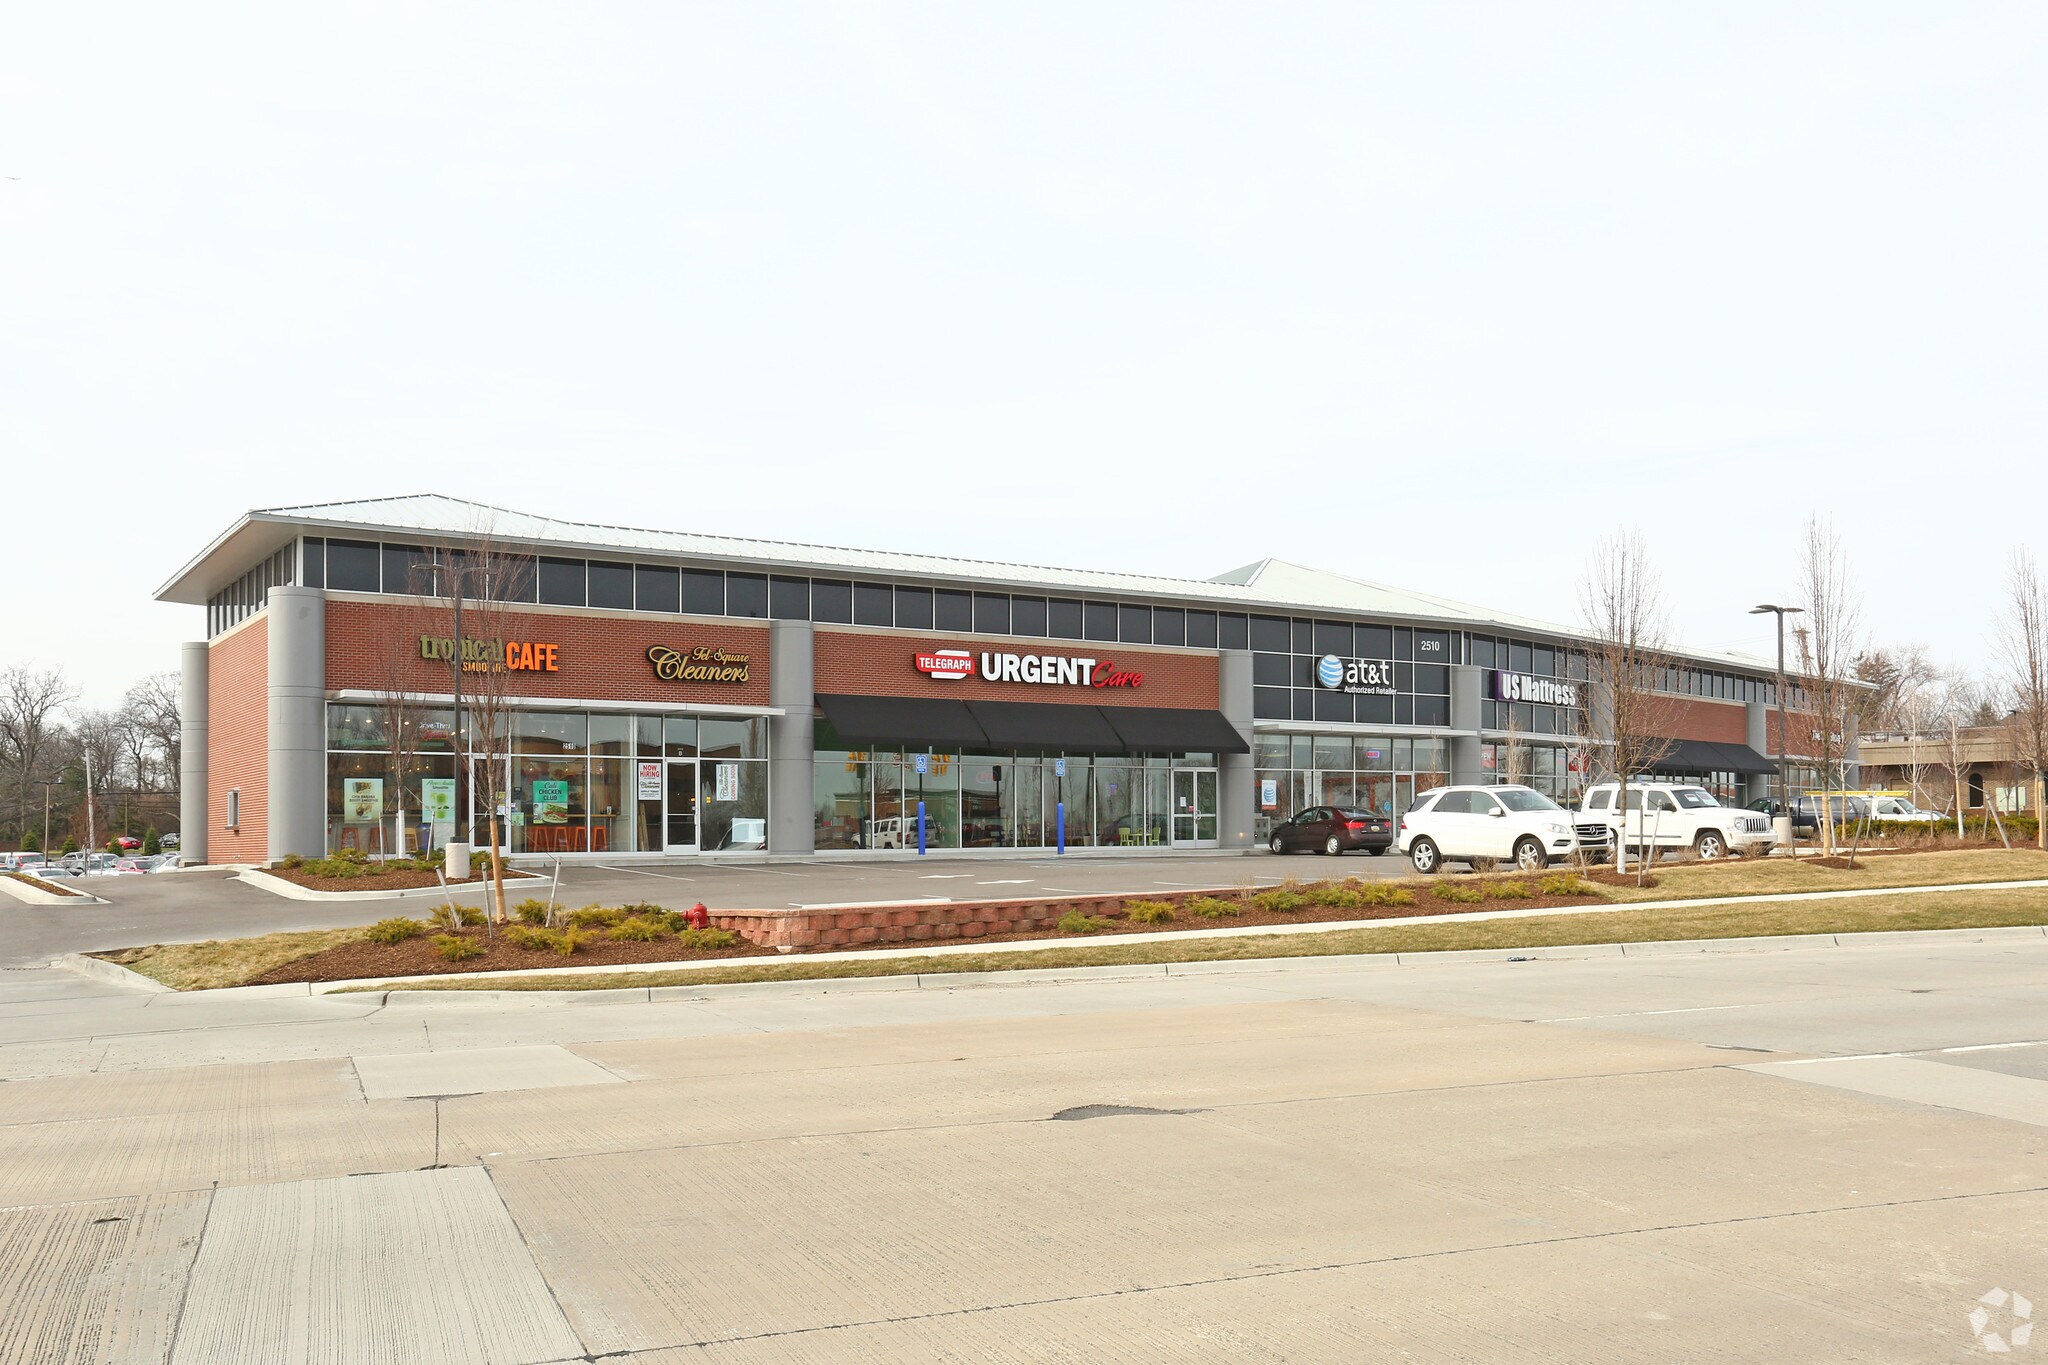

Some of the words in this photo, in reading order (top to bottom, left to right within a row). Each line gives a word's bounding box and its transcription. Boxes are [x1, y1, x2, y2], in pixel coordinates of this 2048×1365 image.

[506, 641, 559, 672] CAFE
[692, 646, 749, 665] Tel-Square
[1421, 641, 1440, 651] 2510
[649, 646, 750, 682] Cleaners
[919, 657, 971, 671] TELEGRAPH
[981, 652, 1096, 686] URGENT
[1092, 660, 1144, 688] Care
[1346, 659, 1390, 685] at&t
[1344, 685, 1375, 695] Authorized
[1376, 687, 1398, 696] Retailer
[1502, 673, 1520, 700] US
[1521, 676, 1576, 706] Mattress
